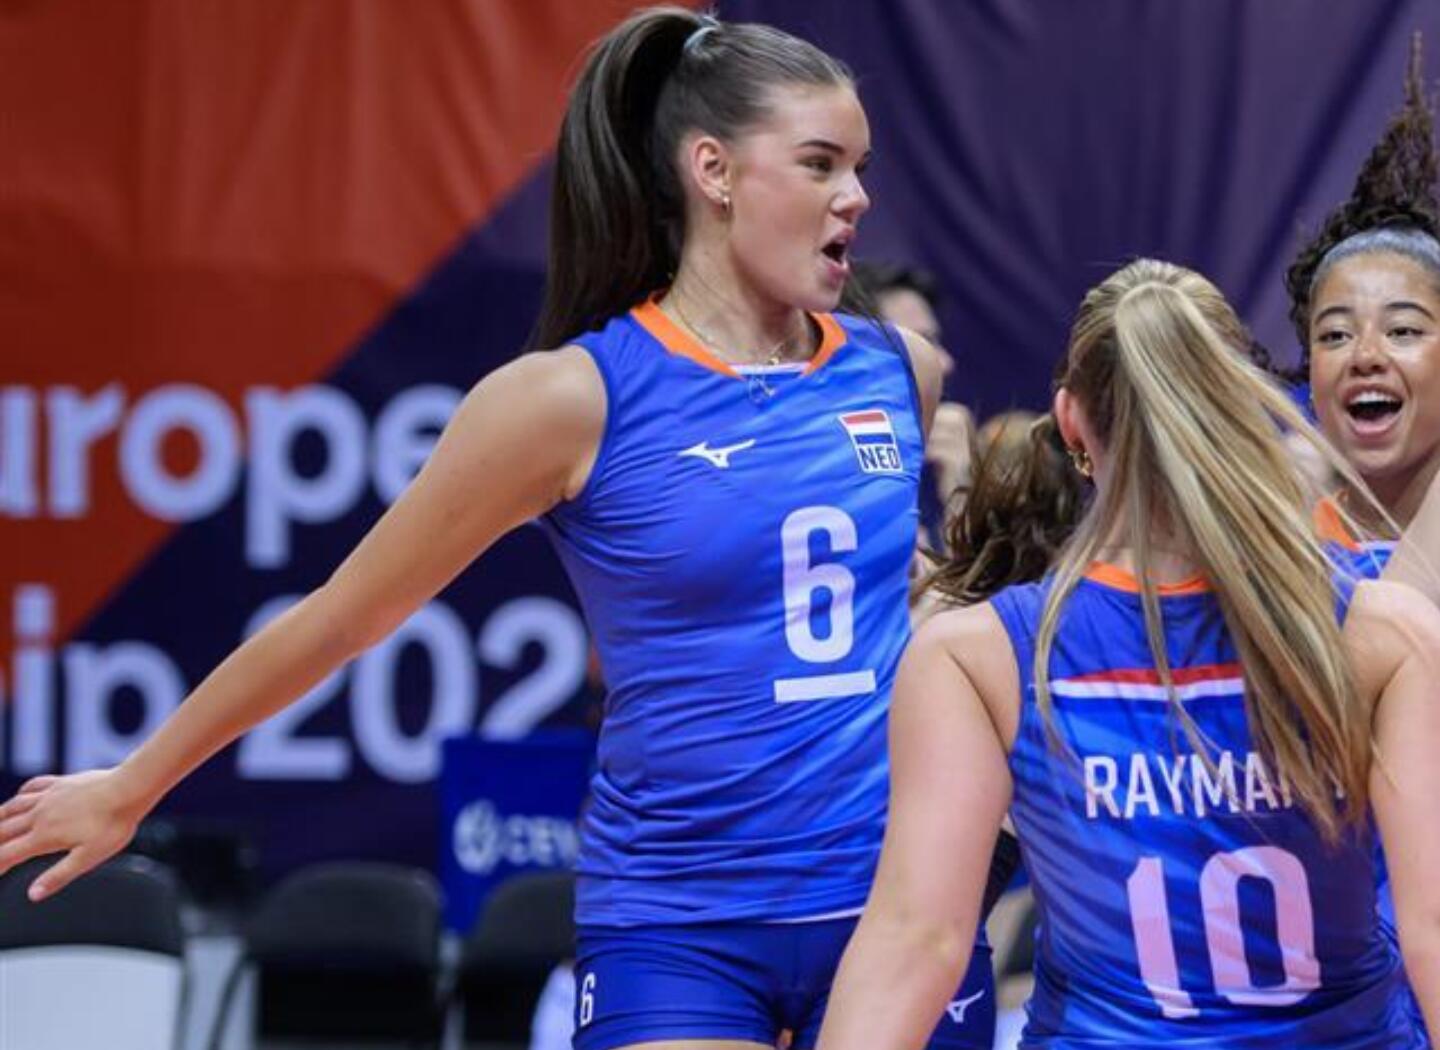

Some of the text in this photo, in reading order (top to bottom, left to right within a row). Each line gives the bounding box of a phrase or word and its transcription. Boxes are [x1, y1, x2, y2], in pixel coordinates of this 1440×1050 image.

[858, 446, 901, 470] NED
[781, 505, 858, 664] 6
[0, 584, 588, 784] ip 202
[1083, 750, 1344, 820] RAYMA
[1126, 845, 1323, 1019] 10
[580, 972, 596, 1028] 6
